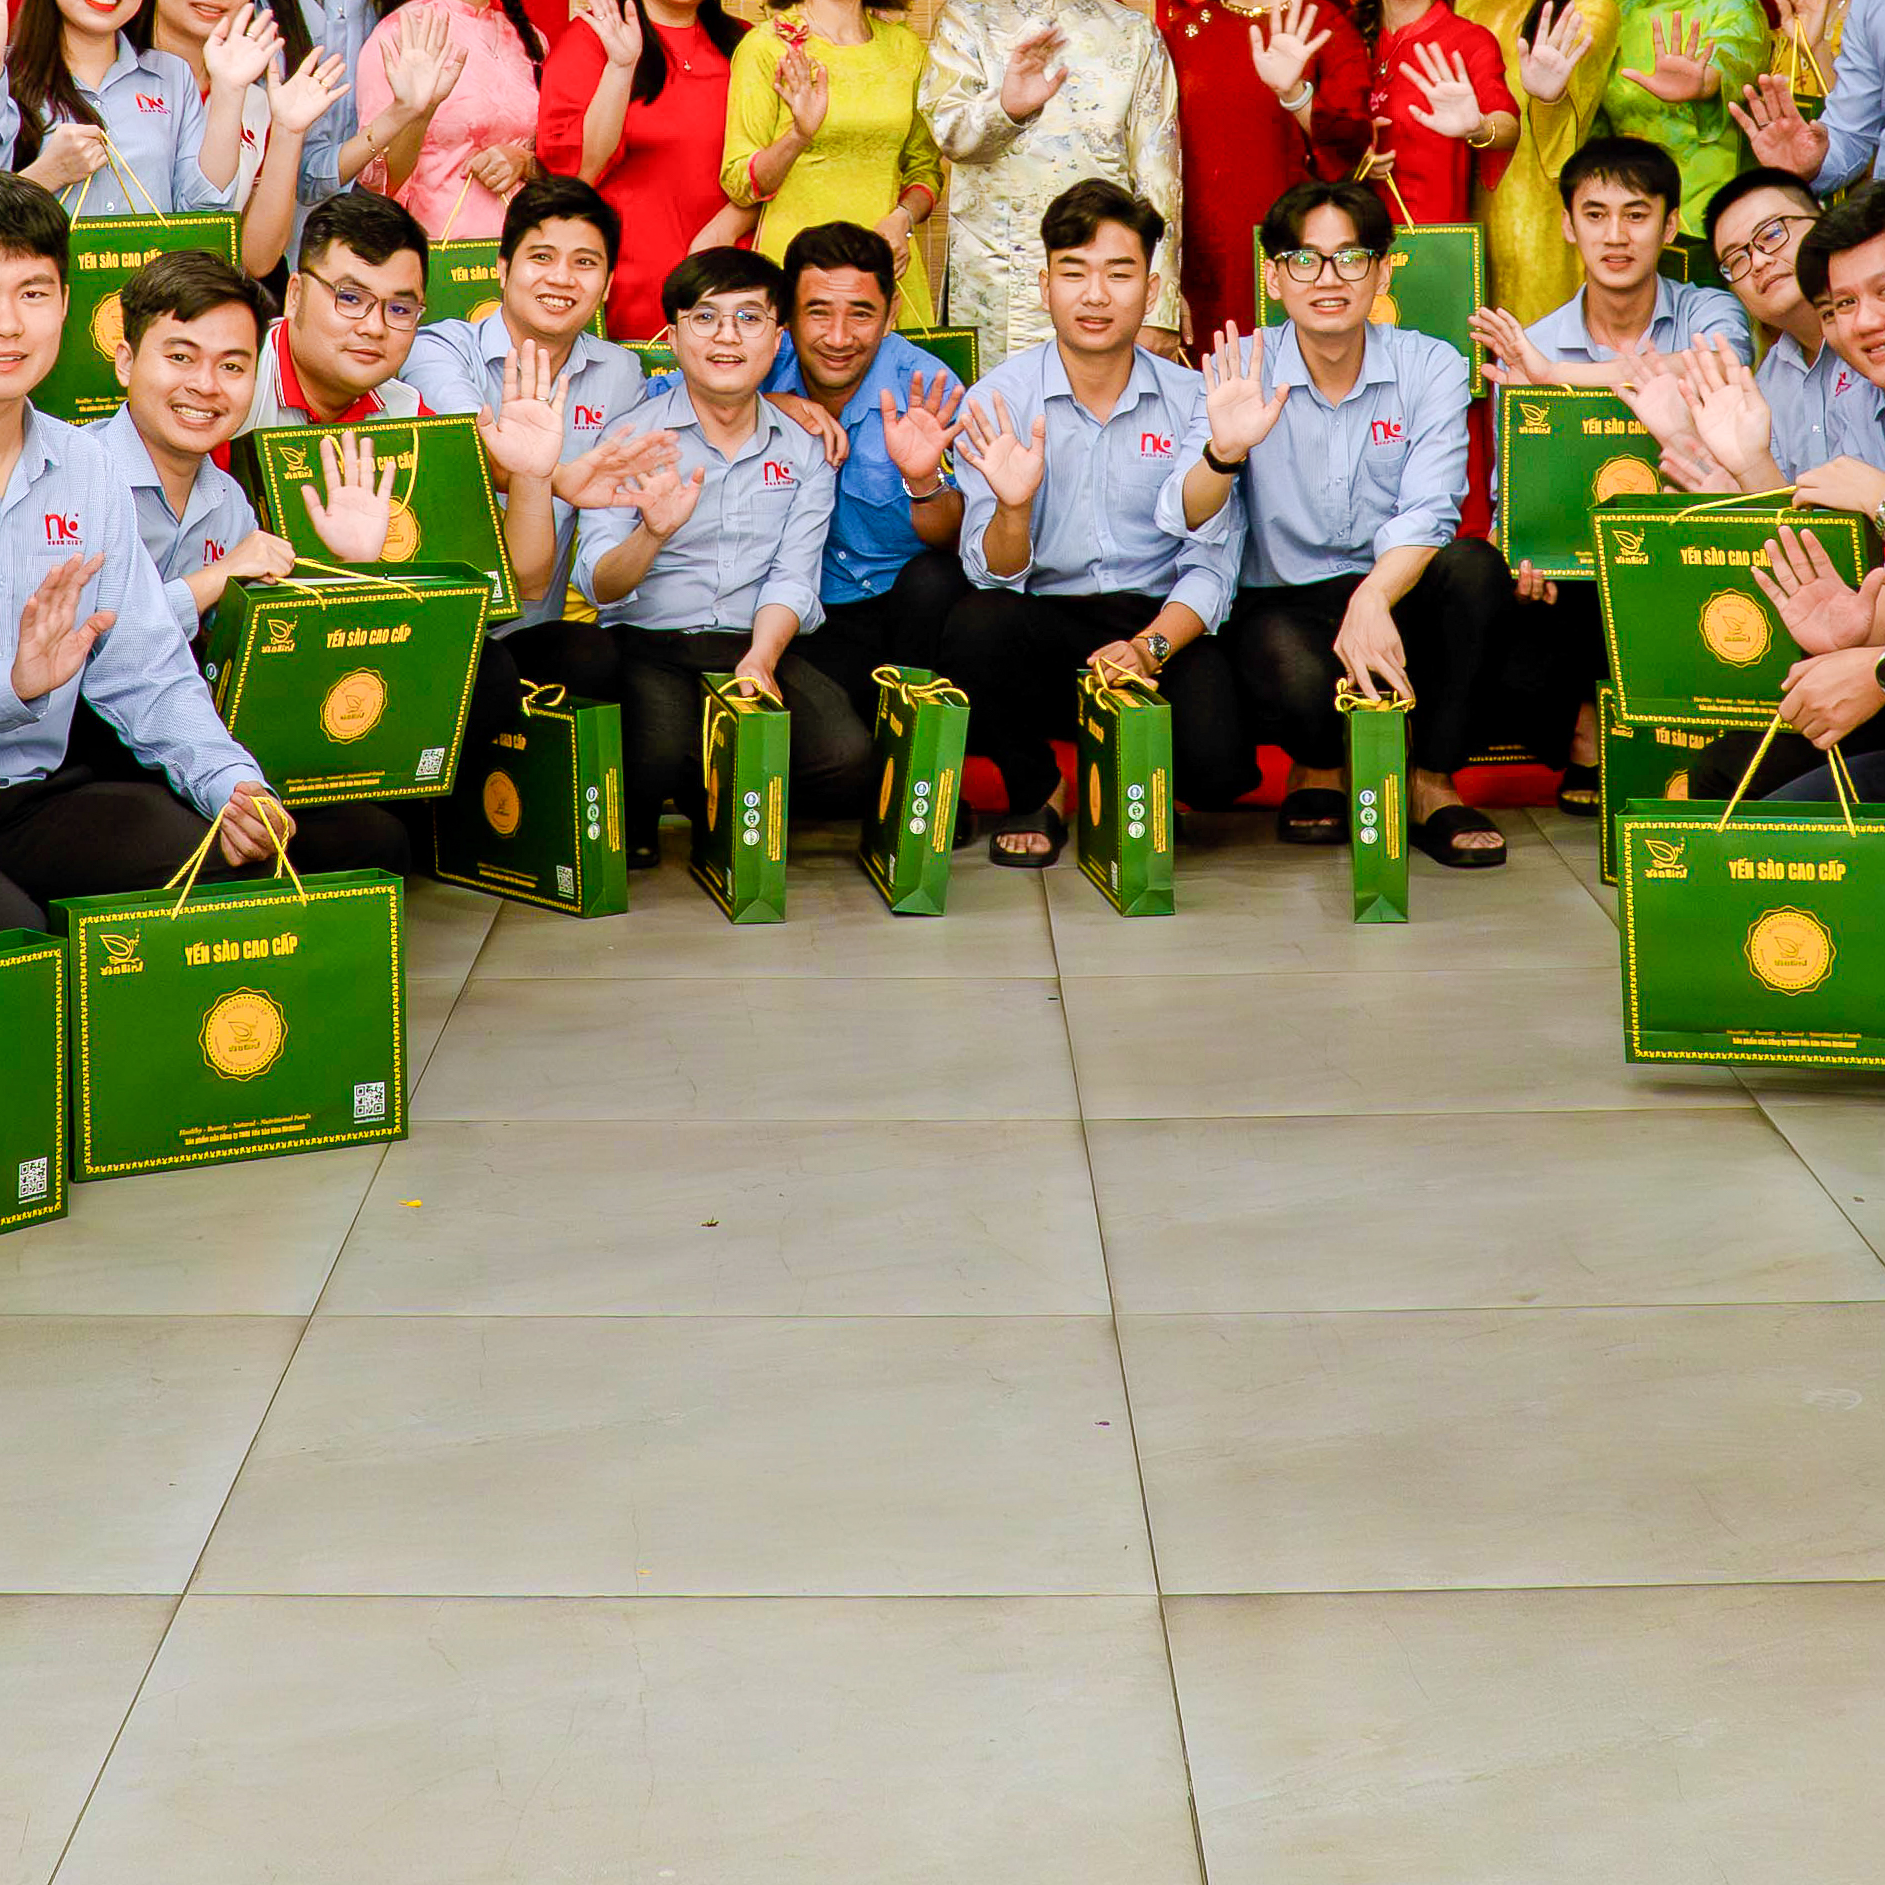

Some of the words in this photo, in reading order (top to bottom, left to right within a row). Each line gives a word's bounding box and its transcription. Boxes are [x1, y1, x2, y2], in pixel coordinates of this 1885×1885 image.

[78, 252, 97, 270] YẾN
[100, 251, 119, 268] SÀO
[121, 252, 141, 268] CAO
[451, 266, 469, 281] YẾN
[471, 265, 489, 280] SÀO
[1582, 417, 1602, 434] YẾN
[1604, 416, 1625, 434] SÀO
[1680, 546, 1702, 565] YẾN
[1704, 546, 1726, 566] SÀO
[1728, 549, 1750, 566] CAO
[327, 629, 345, 648] YẾN
[347, 627, 367, 647] SÀO
[369, 627, 390, 645] CAO
[391, 623, 412, 643] CẤP
[1655, 727, 1670, 744] YẾN
[1671, 729, 1687, 747] SÀO
[1688, 733, 1704, 750] CAO
[1728, 857, 1755, 880] YẾN
[1757, 858, 1785, 881] SÀO
[1787, 862, 1816, 881] CAO
[1818, 859, 1846, 881] CẤP
[185, 941, 210, 966] YẾN
[213, 938, 240, 963] SÀO
[242, 936, 269, 960] CAO
[272, 931, 298, 956] CẤP
